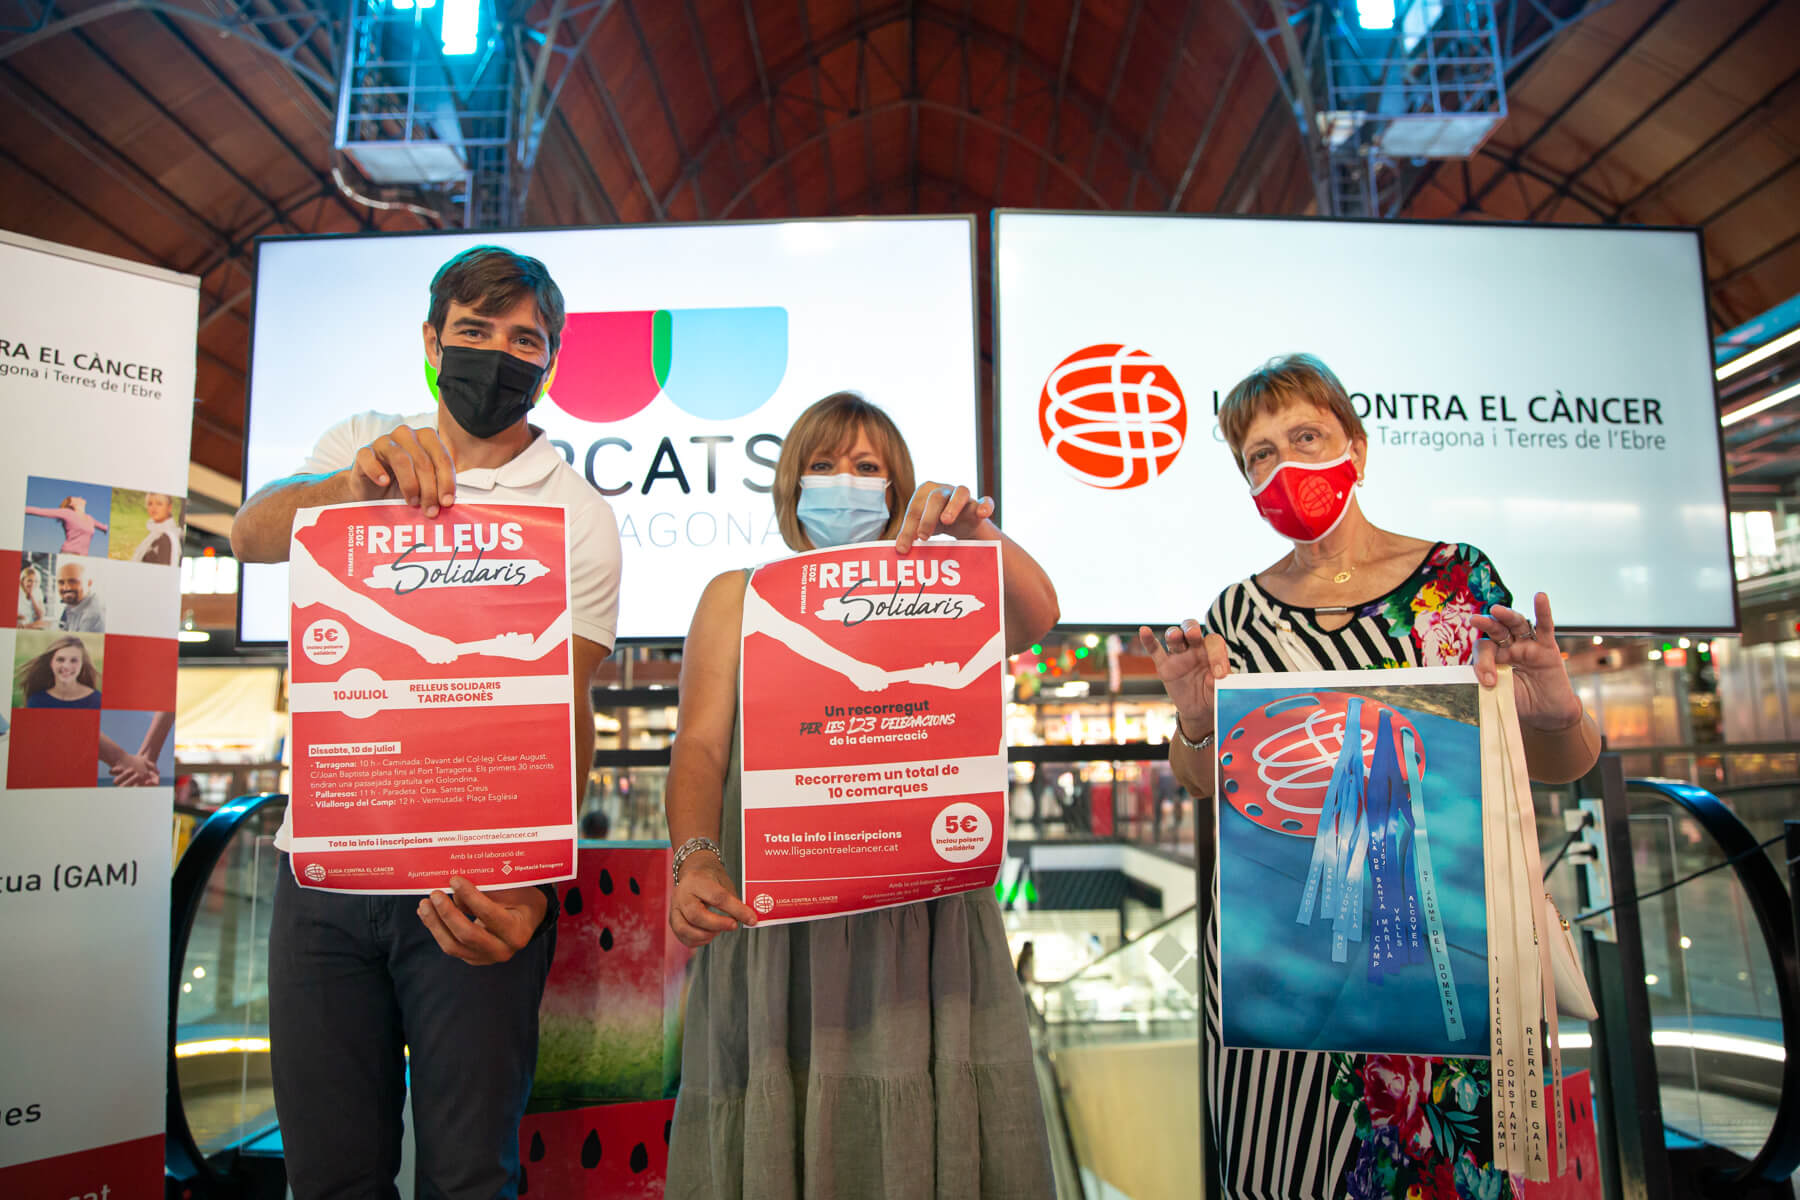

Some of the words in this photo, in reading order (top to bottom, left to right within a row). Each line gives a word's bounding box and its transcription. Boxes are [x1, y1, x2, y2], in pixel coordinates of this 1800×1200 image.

[0, 339, 30, 360] RA
[39, 346, 65, 366] EL
[73, 352, 163, 384] CÀNCER
[44, 367, 48, 380] i
[54, 369, 97, 389] Terres
[101, 379, 118, 392] de
[123, 382, 162, 400] l'Ebre
[1350, 392, 1468, 421] ONTRA
[1480, 395, 1517, 422] EL
[1528, 390, 1664, 425] CÀNCER
[1377, 425, 1485, 451] Tarragona
[1492, 427, 1497, 446] i
[1504, 428, 1568, 448] Terres
[1575, 429, 1600, 449] de
[1607, 429, 1666, 451] l'Ebre
[356, 525, 365, 547] 2021
[368, 522, 523, 553] RELLEUS
[619, 511, 783, 548] AGONA
[391, 543, 526, 595] Solidaris
[819, 559, 961, 588] RELLEUS
[840, 578, 963, 627] Solidaris
[313, 628, 338, 642] 5€
[409, 683, 449, 692] RELLEUS
[450, 681, 501, 691] SOLIDARIS
[418, 690, 493, 703] TARRAGONÈS
[824, 705, 845, 717] Un
[848, 700, 930, 716] recorregut
[799, 721, 823, 736] PER
[824, 720, 845, 734] LES
[880, 713, 956, 730] DELEGACIONS
[829, 734, 844, 746] de
[846, 734, 857, 745] la
[858, 729, 928, 744] demarcació
[351, 746, 360, 754] 10
[362, 745, 373, 753] de
[374, 744, 395, 755] juliol
[315, 761, 357, 771] Tarragona:
[360, 759, 369, 767] 10
[795, 771, 881, 786] Recorrerem
[884, 769, 903, 780] un
[905, 765, 939, 778] total
[941, 763, 960, 775] de
[828, 786, 842, 799] 10
[845, 782, 929, 798] comarques
[356, 798, 369, 807] del
[764, 833, 790, 843] Tota
[791, 832, 802, 842] la
[804, 832, 826, 842] info
[833, 829, 903, 843] inscripcions
[945, 815, 978, 834] 5€
[328, 840, 348, 848] Tota
[349, 839, 358, 848] la
[359, 838, 375, 848] info
[380, 836, 433, 847] inscripcions
[0, 873, 41, 893] ua
[53, 859, 138, 893] (GAM)
[1394, 907, 1403, 947] VALLS
[1408, 895, 1418, 948] ALCOVER
[1432, 930, 1441, 953] DEL
[1438, 963, 1457, 1025] DOMENYS
[1526, 1027, 1535, 1077] RIERA
[1530, 1089, 1537, 1109] DE
[0, 1103, 42, 1126] es
[1497, 1110, 1505, 1150] CAMP
